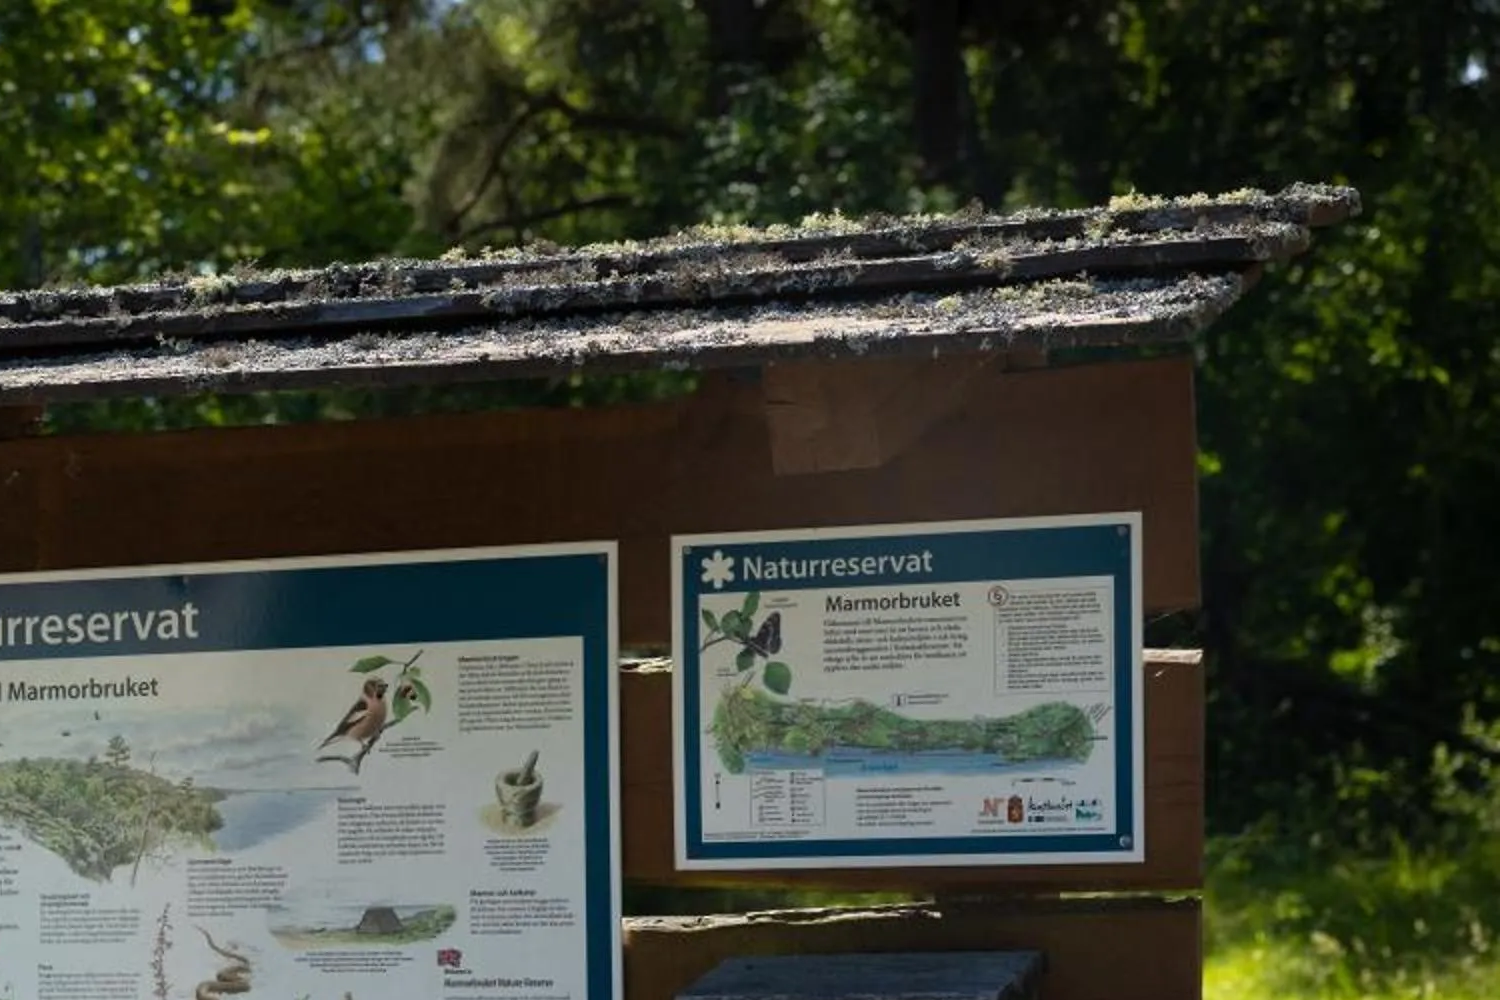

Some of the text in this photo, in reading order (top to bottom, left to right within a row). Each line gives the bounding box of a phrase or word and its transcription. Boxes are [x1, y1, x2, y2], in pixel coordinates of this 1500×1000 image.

[743, 550, 933, 581] Naturreservat
[825, 591, 961, 612] Marmorbruket
[8, 676, 159, 702] Marmorbruket
